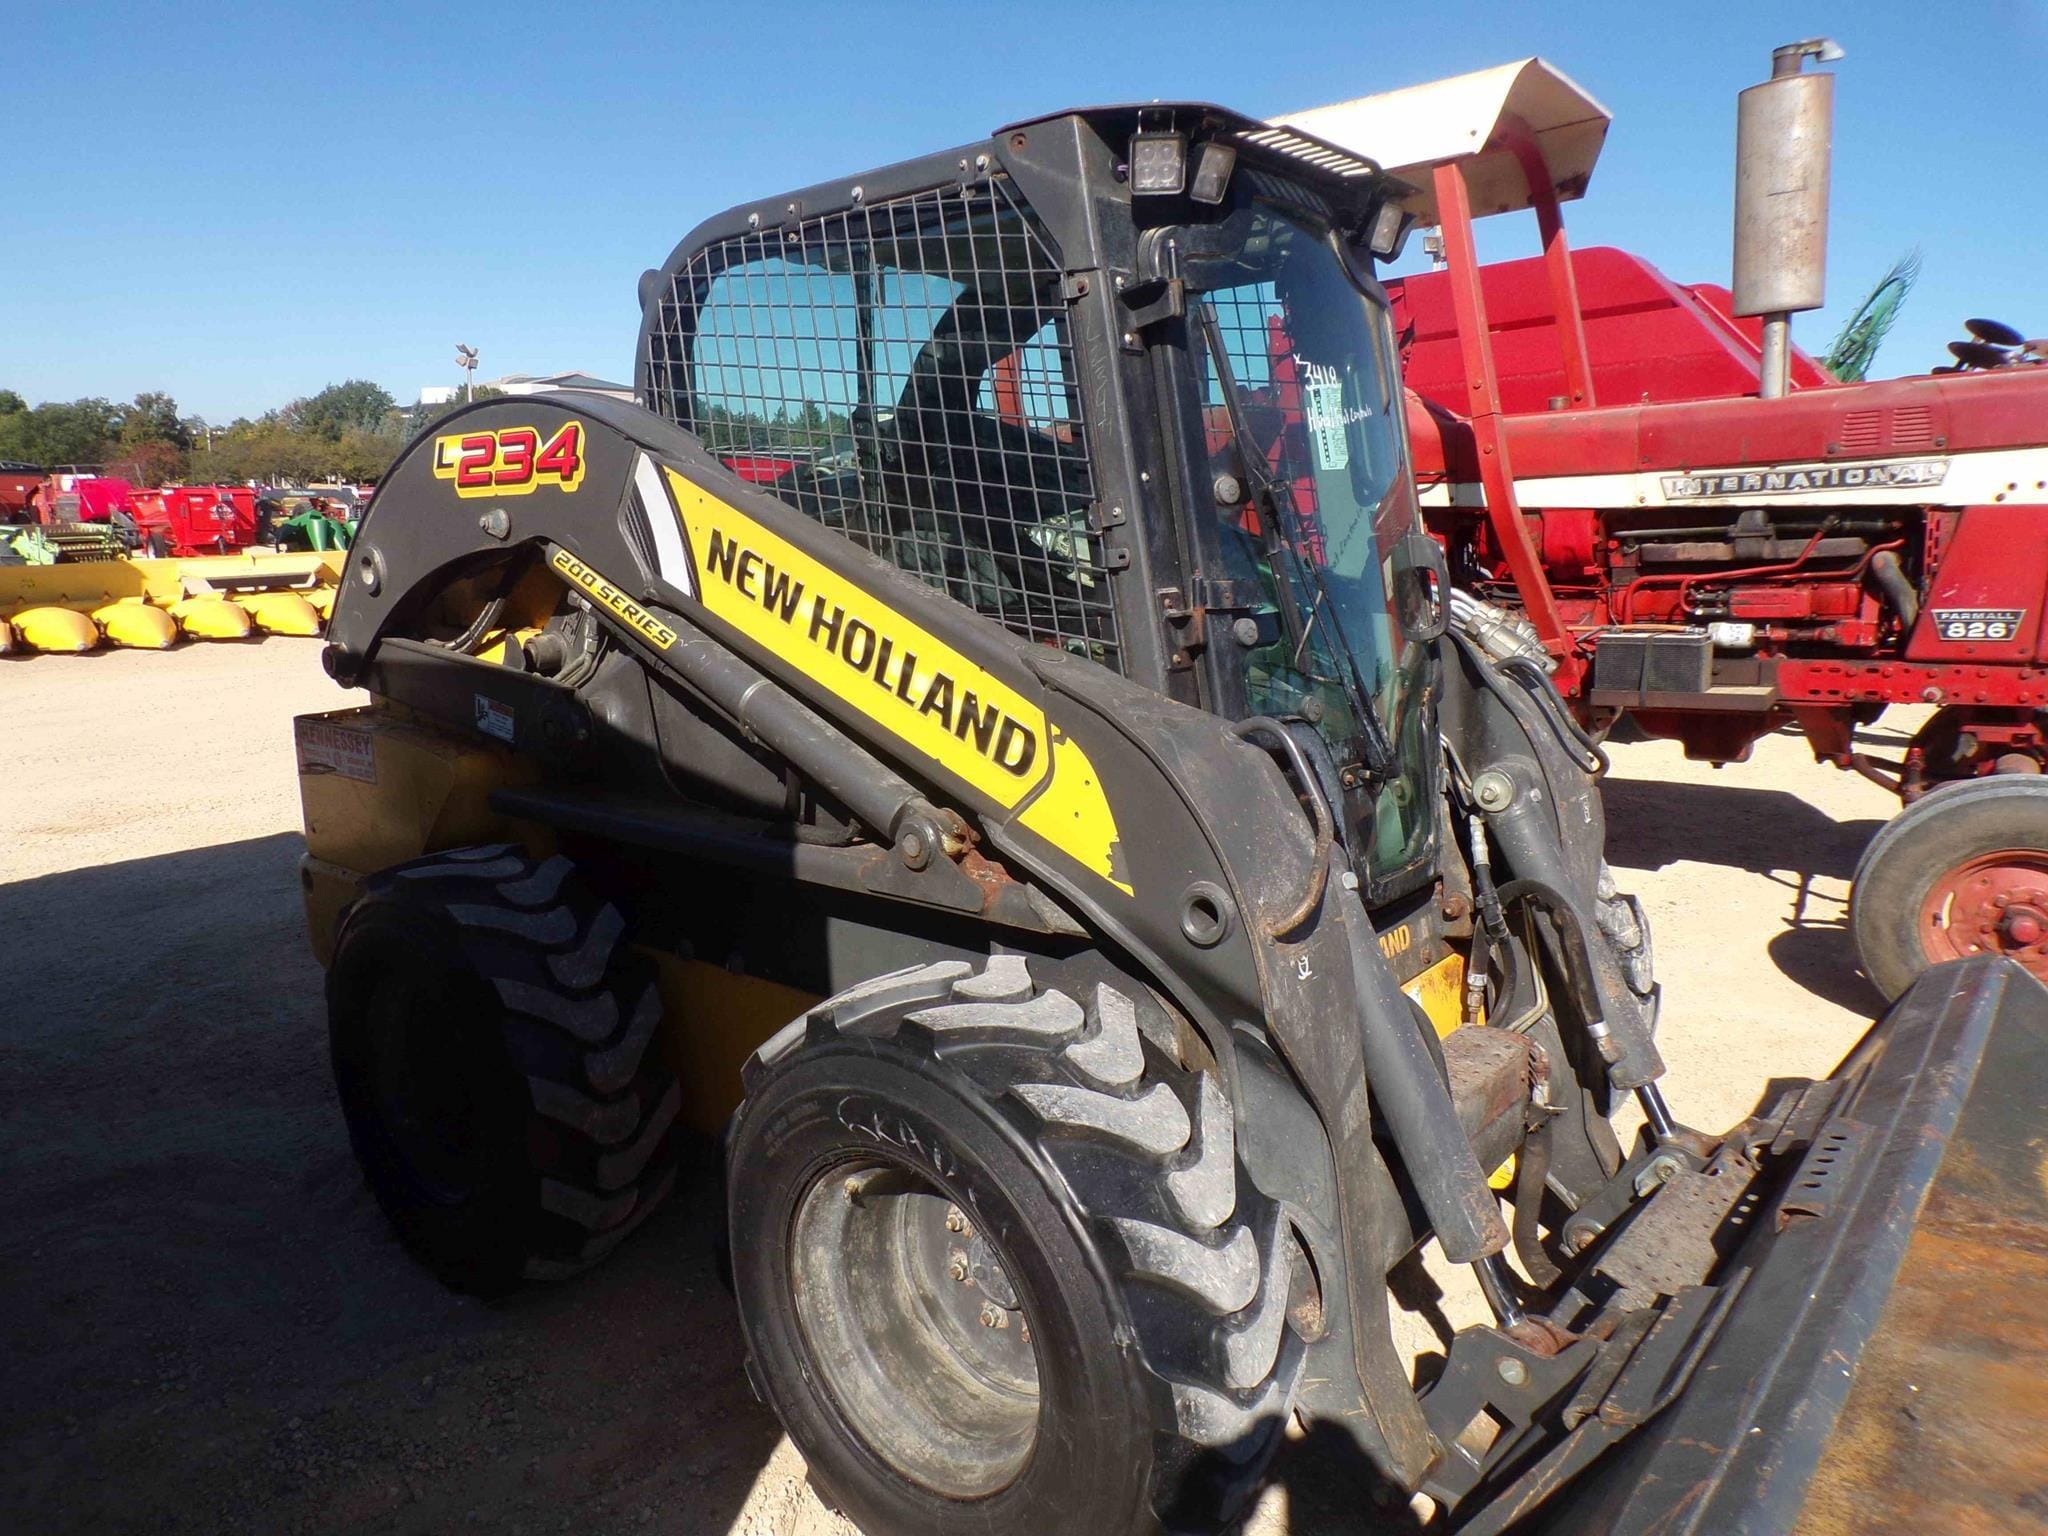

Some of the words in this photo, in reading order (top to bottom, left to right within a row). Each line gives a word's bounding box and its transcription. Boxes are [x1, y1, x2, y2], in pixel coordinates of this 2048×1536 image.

[1673, 462, 1944, 496] INTERNATIONAL
[554, 552, 596, 588] 200
[597, 586, 674, 645] SERIES
[1947, 622, 2007, 638] 826
[707, 528, 804, 625] NEW
[808, 595, 1037, 778] HOLLAND
